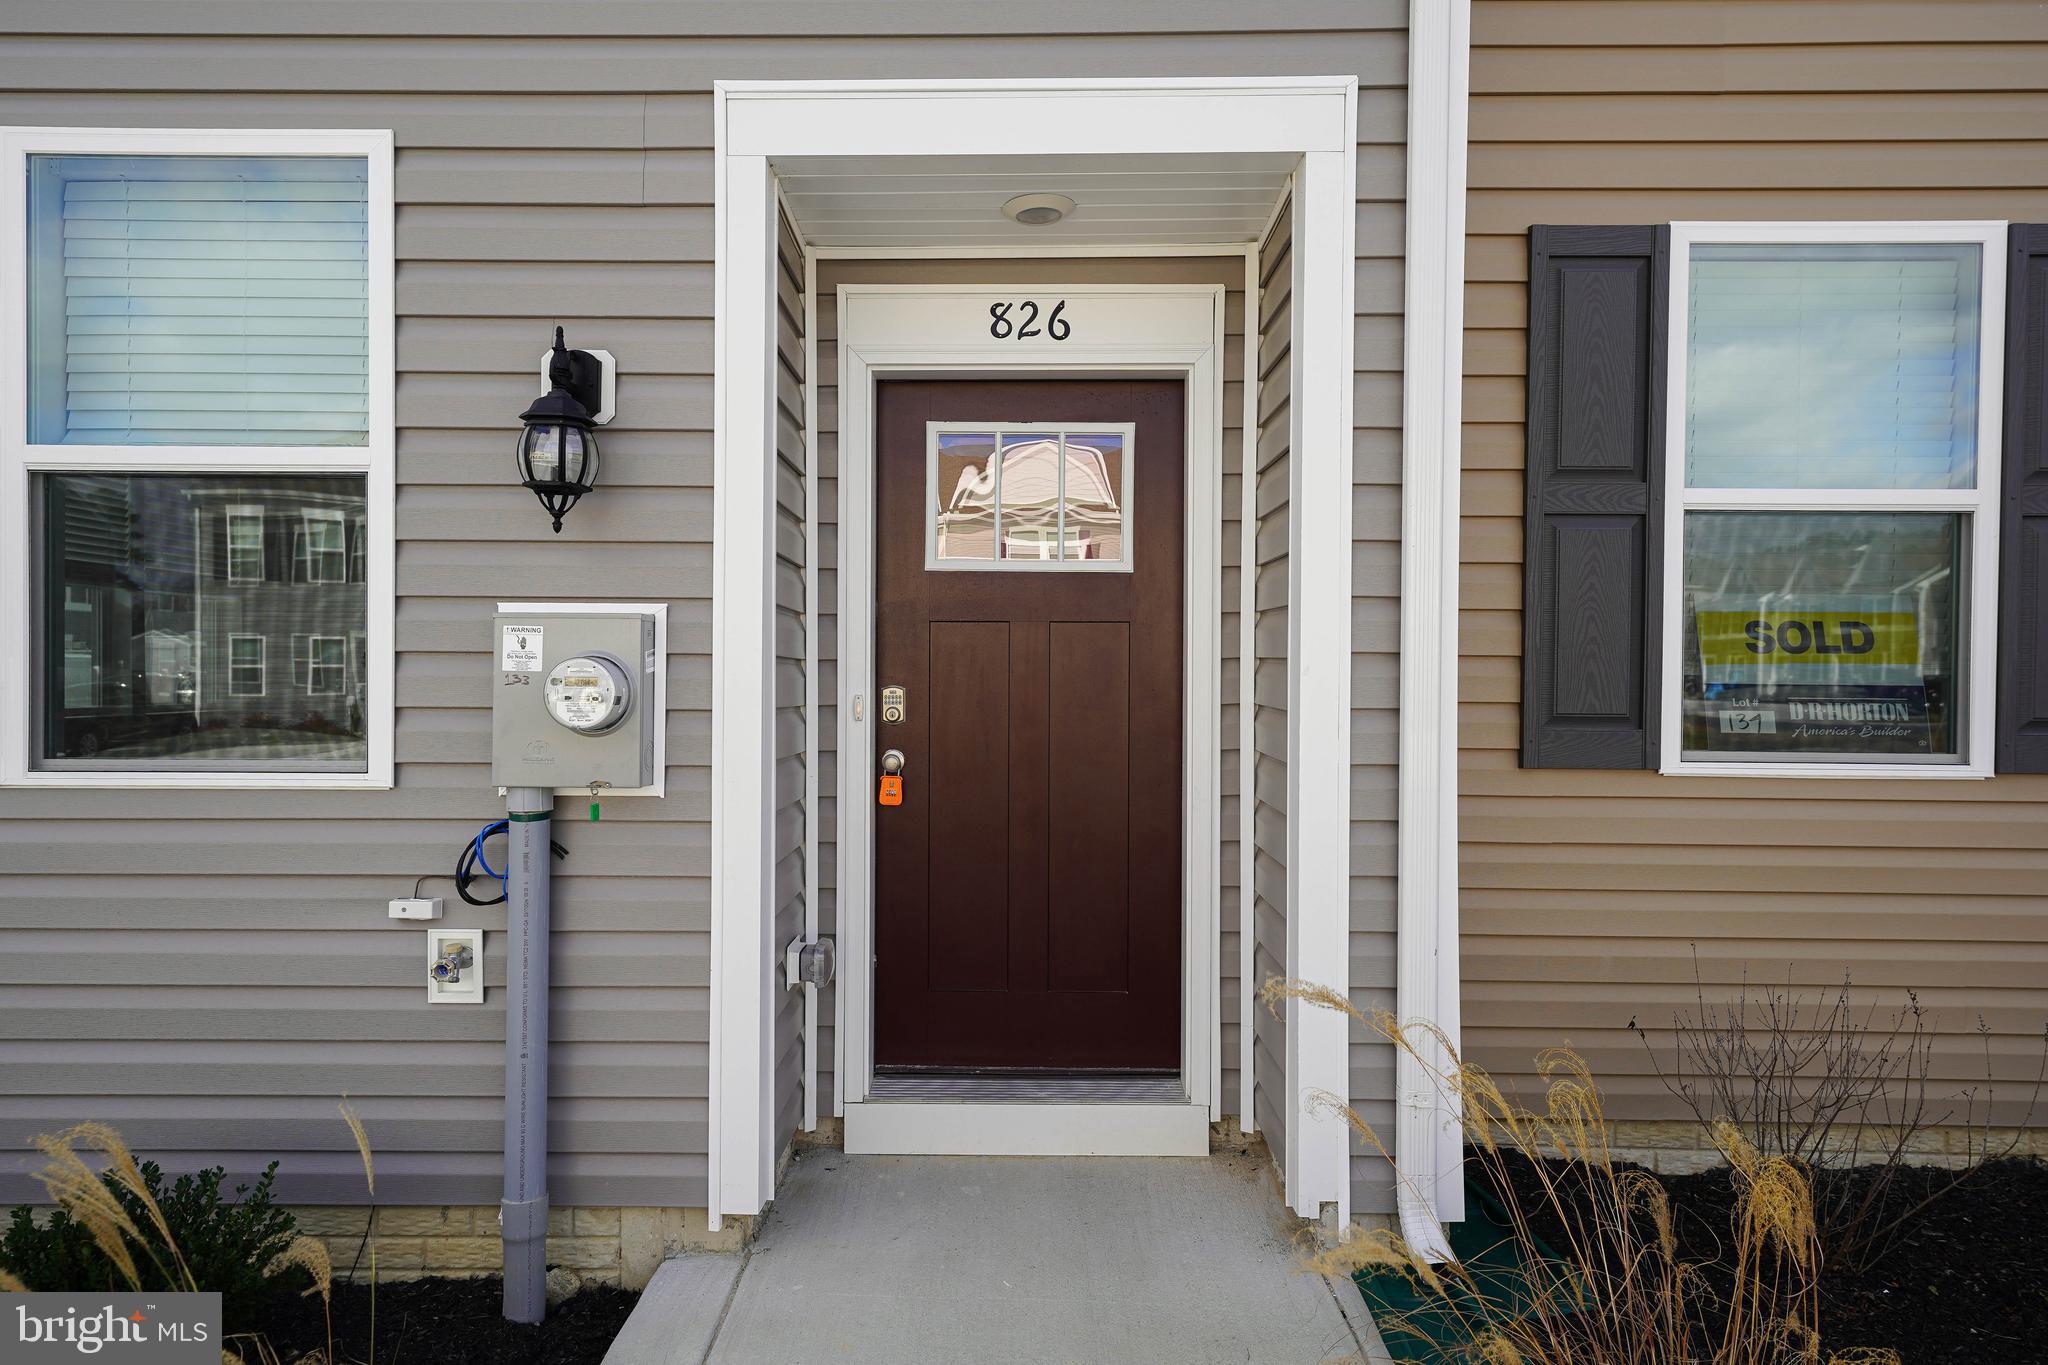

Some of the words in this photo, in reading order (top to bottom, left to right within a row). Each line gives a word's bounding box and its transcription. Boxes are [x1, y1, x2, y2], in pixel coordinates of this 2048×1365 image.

[990, 300, 1071, 340] 826
[1744, 620, 1875, 655] SOLD
[504, 673, 530, 686] 133
[1732, 697, 1750, 707] Lot
[1752, 698, 1759, 707] #
[1791, 724, 1856, 738] America's
[1858, 725, 1912, 738] Builder
